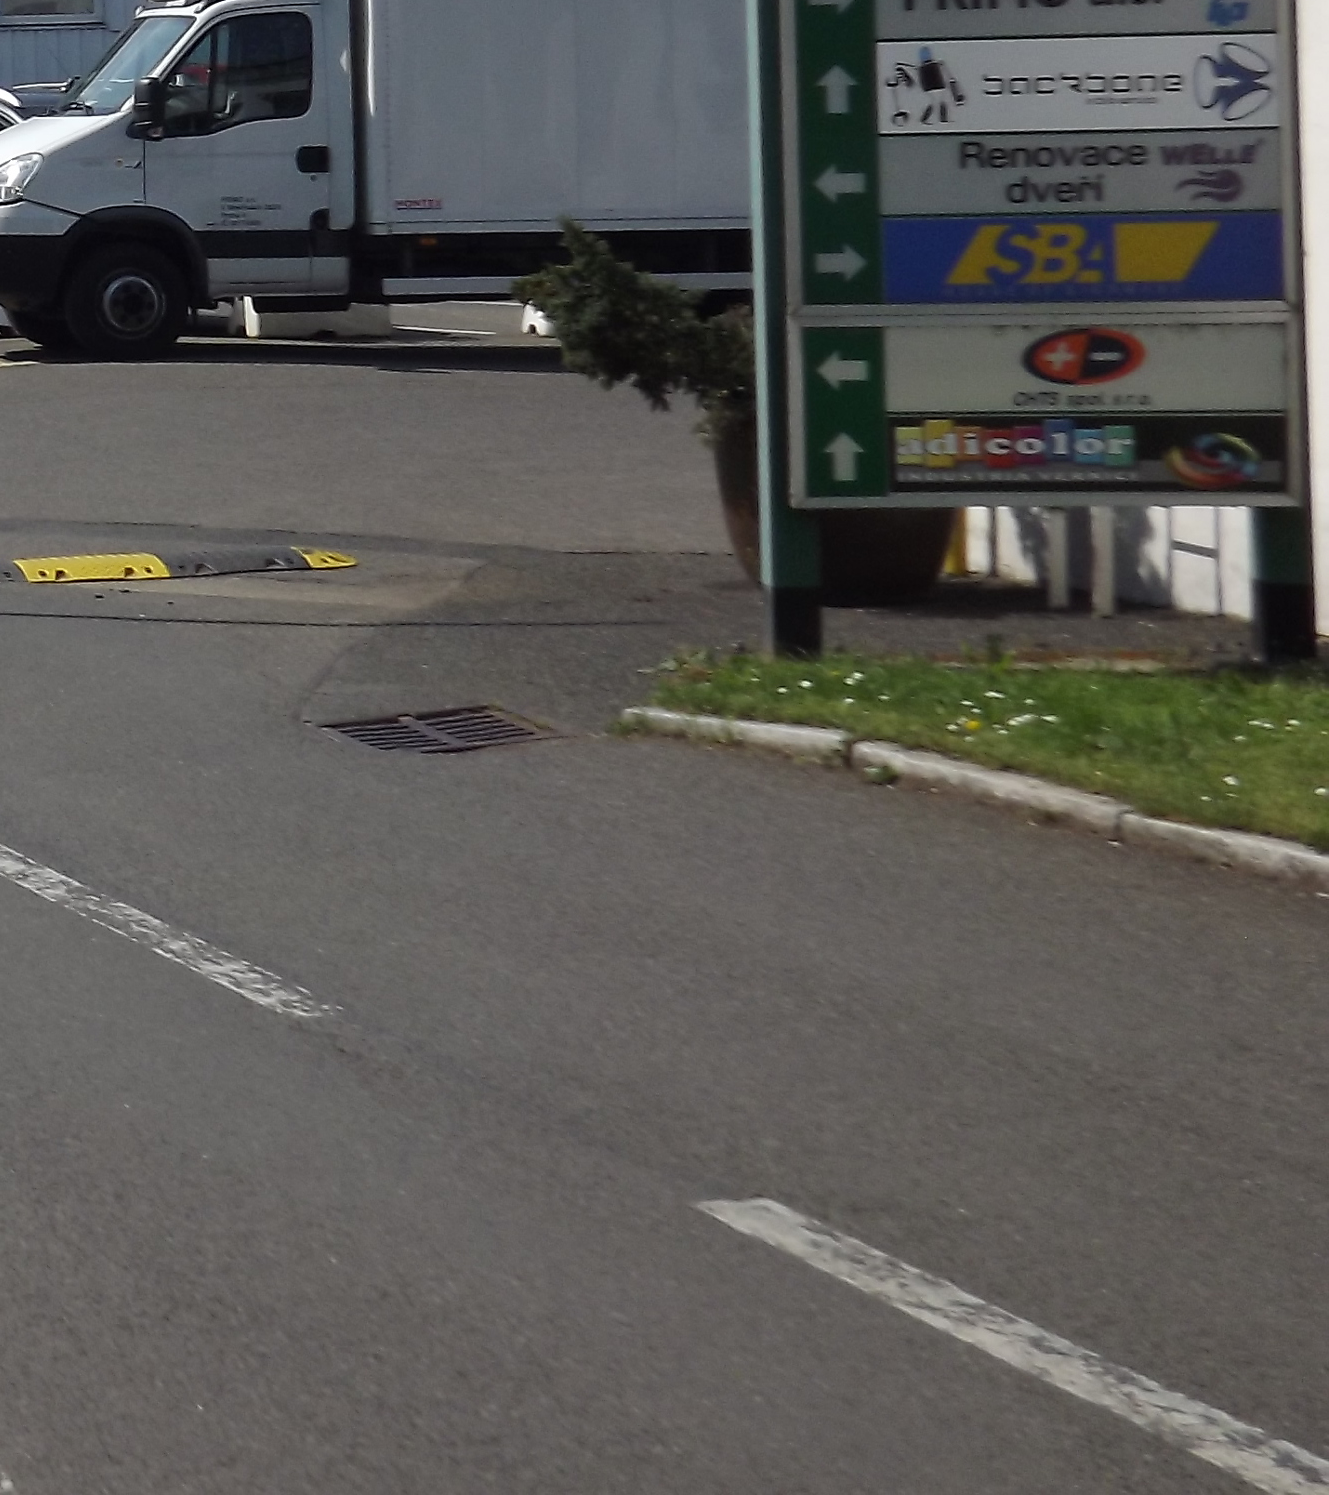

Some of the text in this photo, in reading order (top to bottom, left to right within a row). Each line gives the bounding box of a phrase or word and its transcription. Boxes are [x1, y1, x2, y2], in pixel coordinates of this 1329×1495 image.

[959, 141, 1149, 169] Renovace
[1005, 174, 1105, 204] dveří
[896, 431, 1135, 457] adicolor
